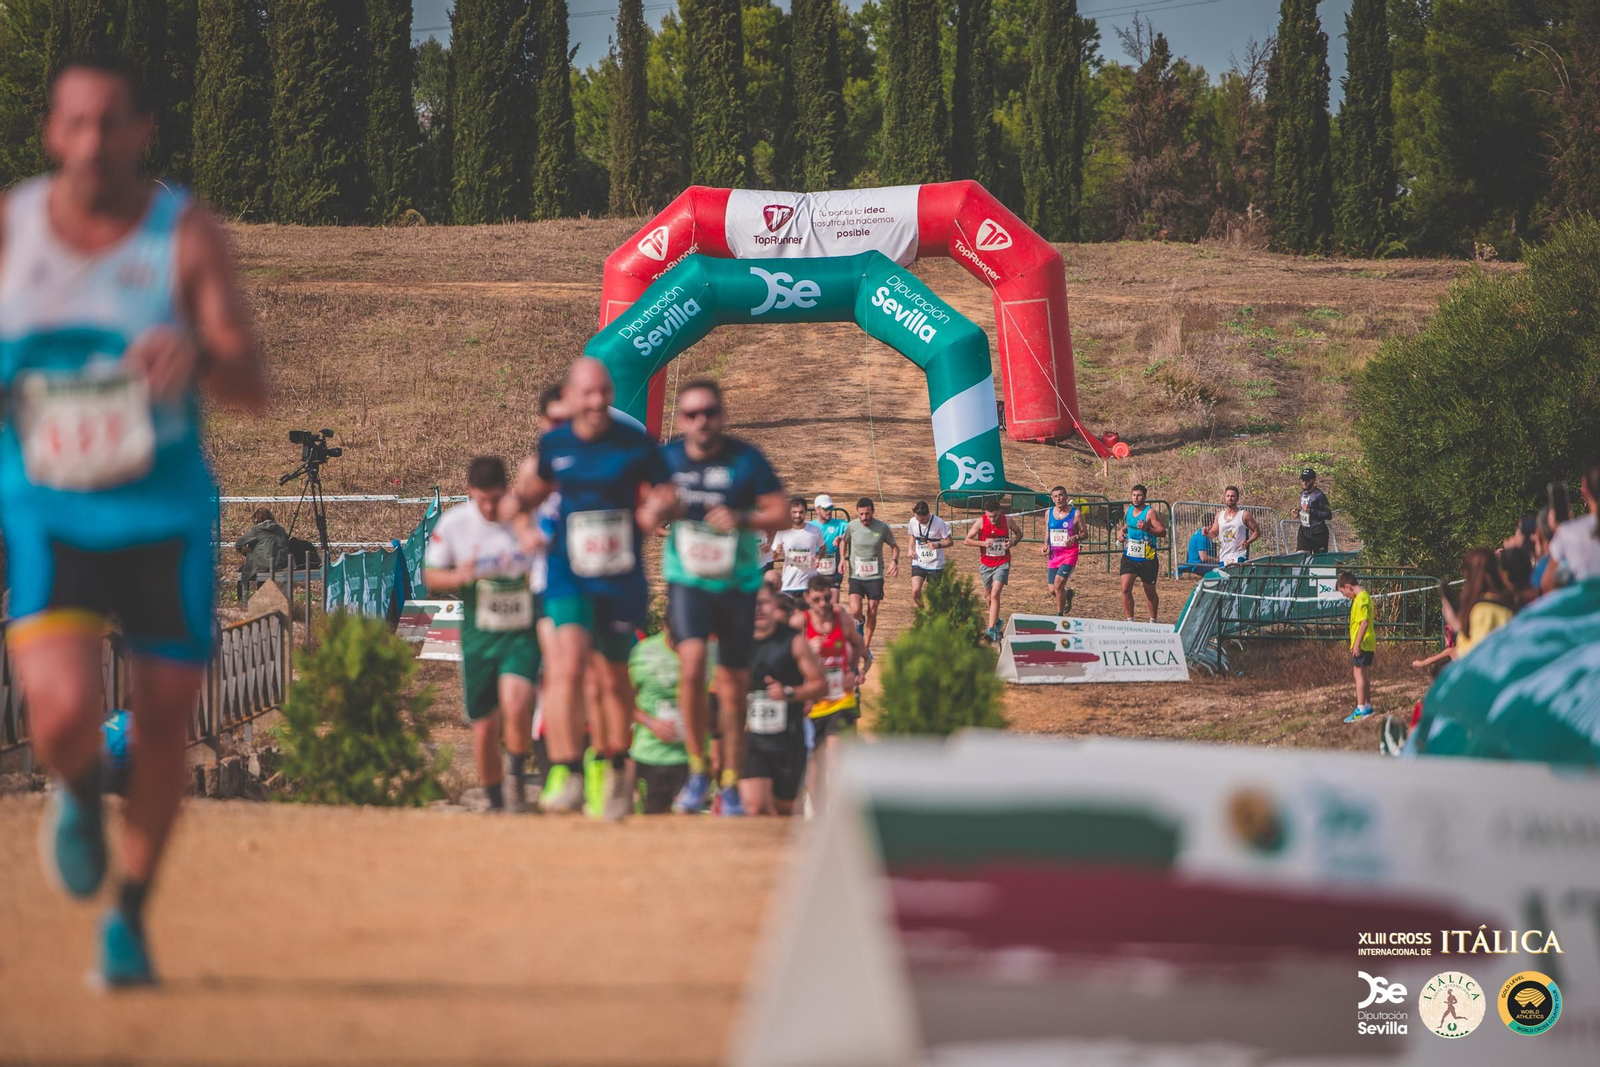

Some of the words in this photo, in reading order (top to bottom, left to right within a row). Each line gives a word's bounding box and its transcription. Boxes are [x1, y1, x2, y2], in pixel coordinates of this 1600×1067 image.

[847, 218, 855, 226] la
[753, 235, 803, 247] TopRunner
[836, 228, 870, 239] posible
[954, 239, 1001, 281] TopRunner
[885, 274, 951, 325] Diputación
[618, 285, 685, 340] Diputación
[871, 286, 938, 344] Sevilla
[633, 297, 702, 356] Sevilla
[920, 550, 934, 558] 446
[1129, 544, 1142, 553] 592
[1102, 646, 1179, 666] ITÁLICA
